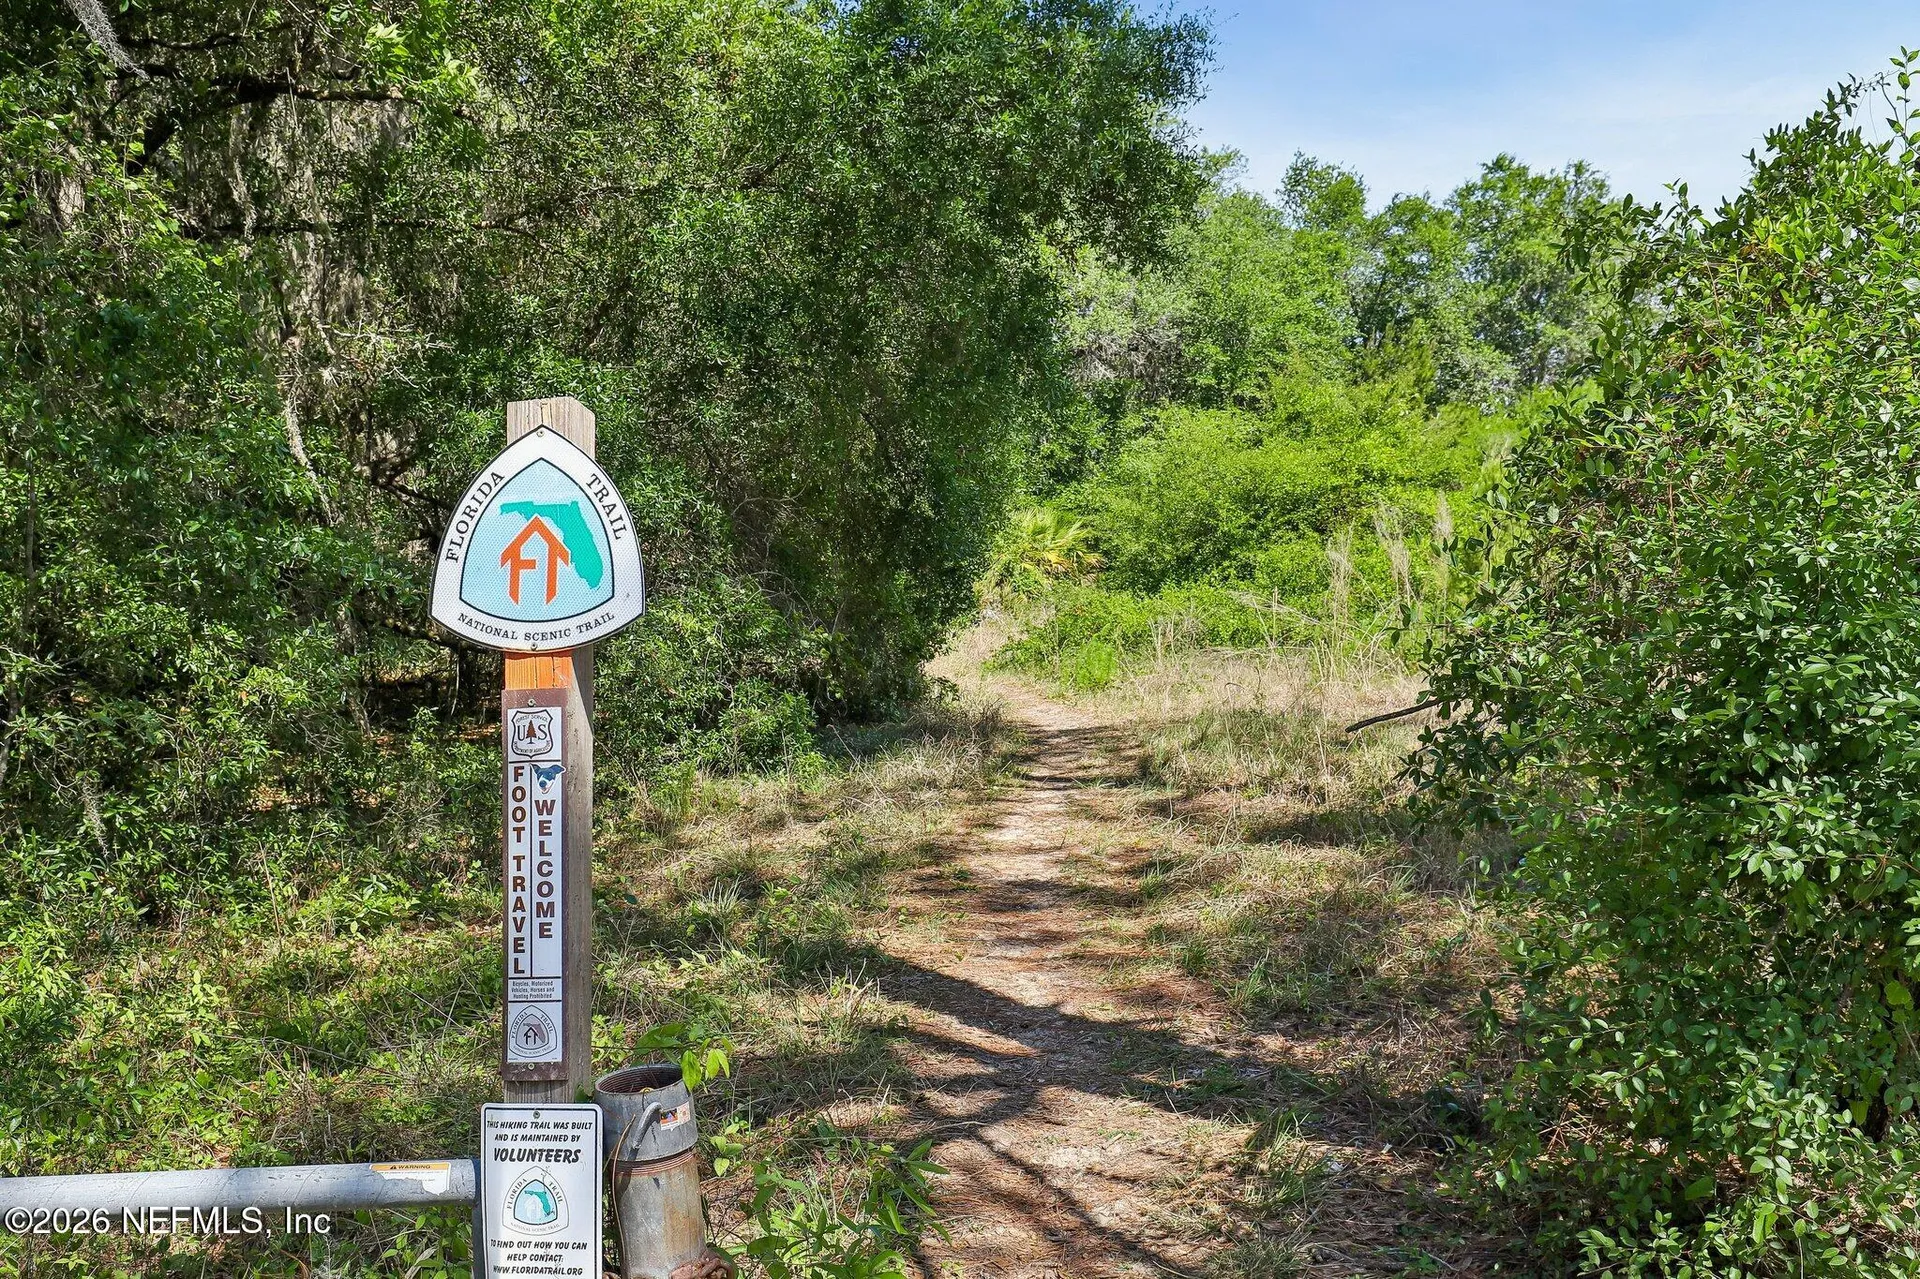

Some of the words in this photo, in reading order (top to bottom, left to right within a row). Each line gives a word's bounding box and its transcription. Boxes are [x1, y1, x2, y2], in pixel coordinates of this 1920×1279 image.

[445, 471, 505, 563] FLORIDA
[586, 473, 627, 540] TRAIL
[457, 612, 518, 640] NATIONAL
[524, 628, 571, 641] SCENIC
[577, 612, 615, 634] TRAIL
[511, 765, 527, 843] FOOT
[534, 799, 556, 939] WELCOME
[512, 855, 526, 974] TRAVEL
[540, 1014, 554, 1032] TRAIL
[487, 1120, 500, 1128] THIS
[500, 1121, 528, 1129] HIKING
[553, 1122, 570, 1130] WAS
[571, 1122, 593, 1130] BUILT
[510, 1134, 519, 1142] IS
[520, 1134, 569, 1142] MAINTAINED
[570, 1135, 581, 1143] BY
[493, 1148, 582, 1164] VOLUNTEERS
[506, 1178, 527, 1209] FLORIDA
[549, 1181, 563, 1204] TRAIL
[490, 1239, 497, 1247] TO
[497, 1240, 514, 1248] FIND
[517, 1241, 532, 1249] OUT
[534, 1241, 552, 1249] HOW
[555, 1242, 570, 1250] YOU
[571, 1242, 588, 1250] CAN
[506, 1253, 527, 1261] HELP
[493, 1265, 583, 1275] WWW.FLORIDATRAIL.ORG
